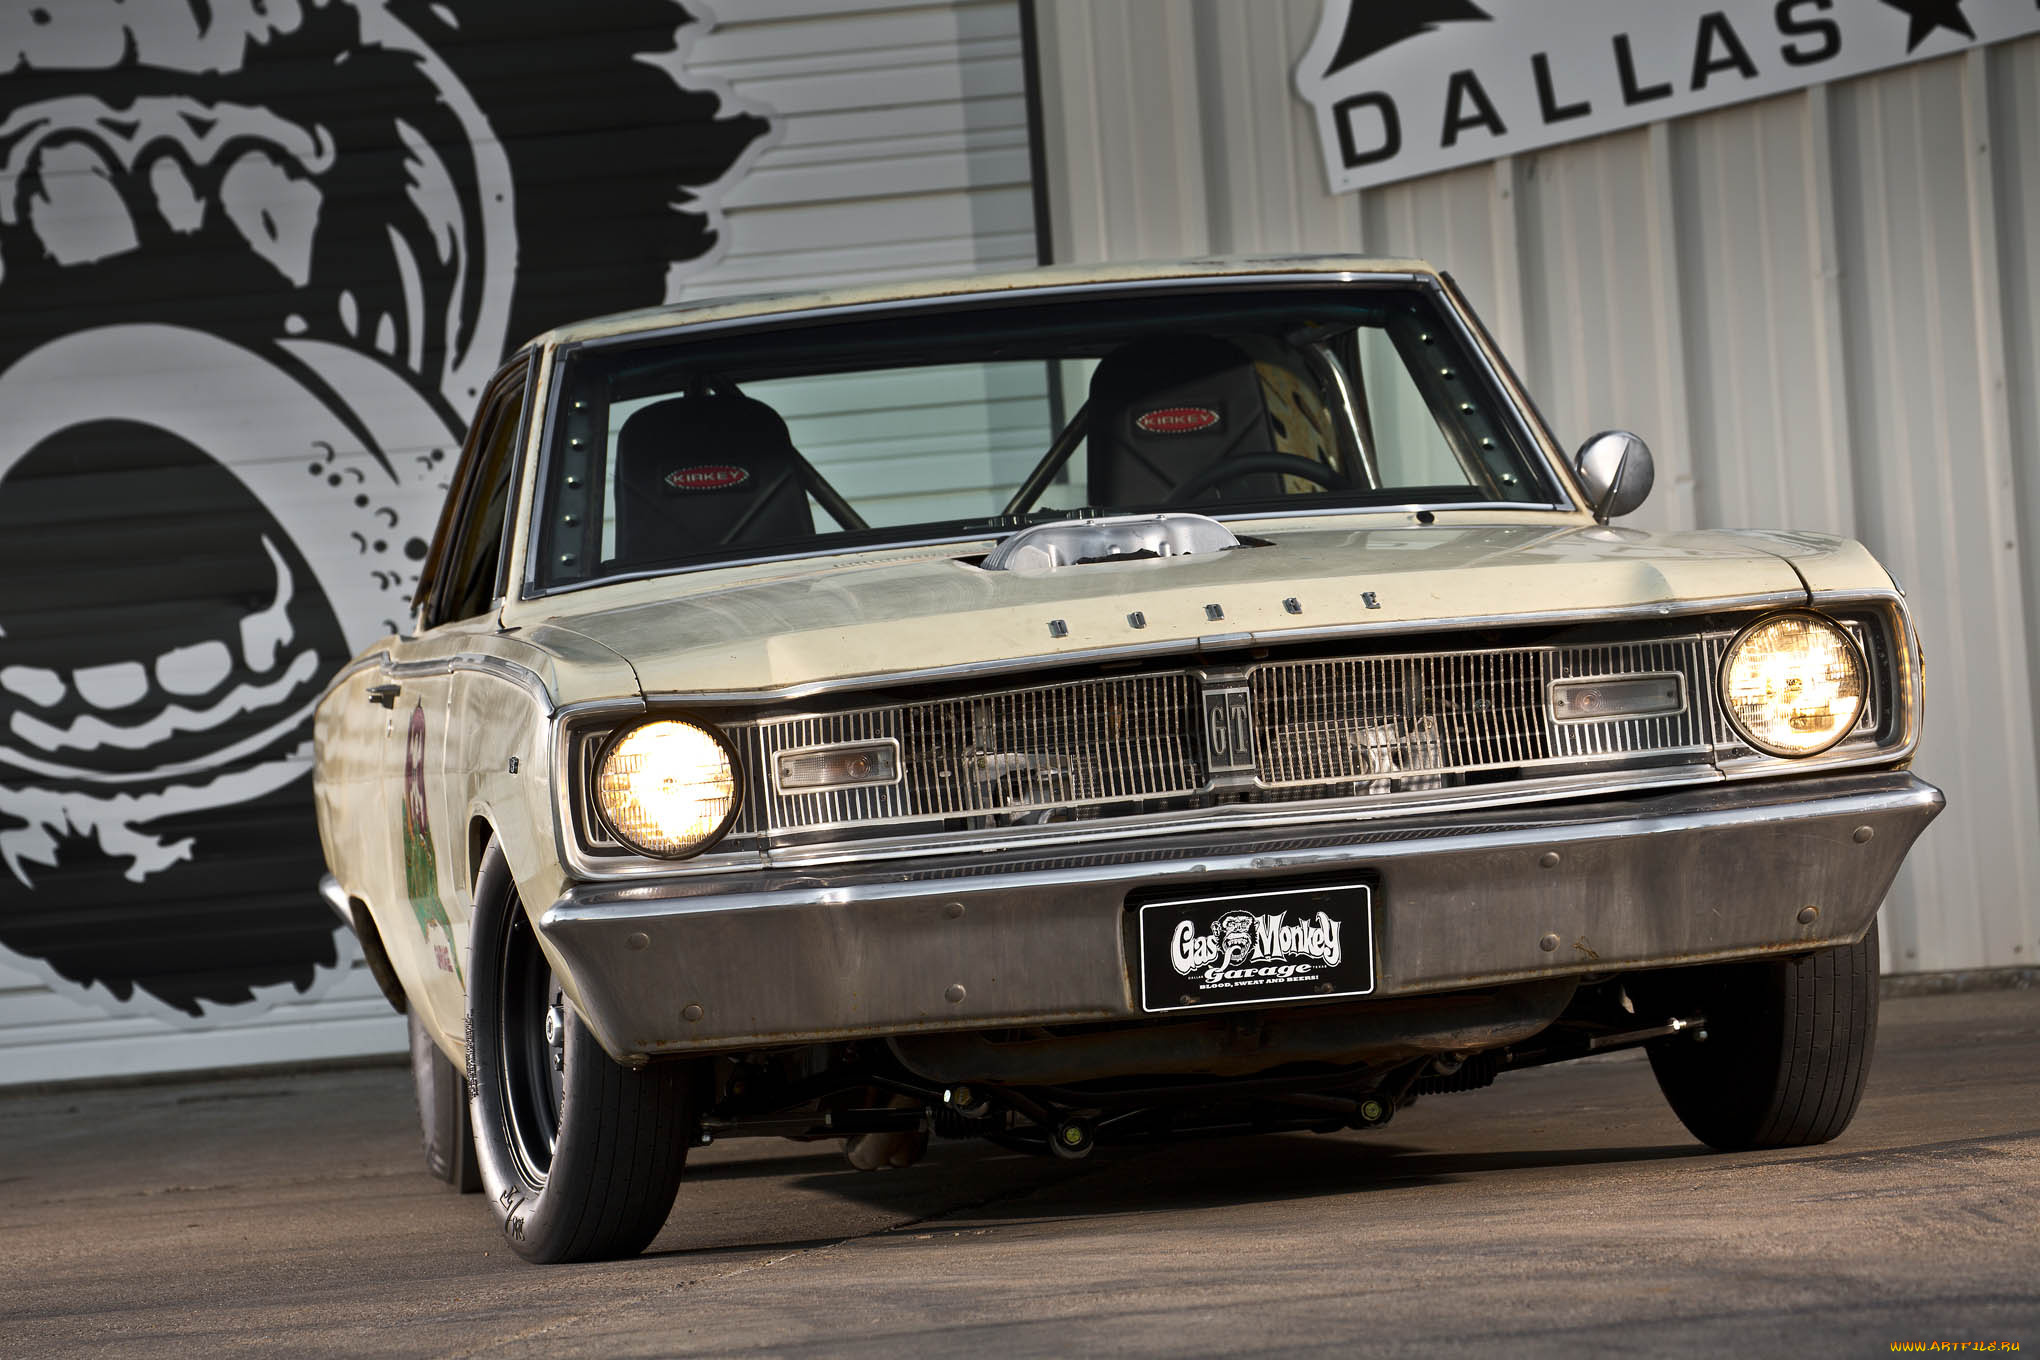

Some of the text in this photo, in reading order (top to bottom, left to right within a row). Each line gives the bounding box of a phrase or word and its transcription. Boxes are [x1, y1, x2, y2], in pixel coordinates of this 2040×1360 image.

[1332, 0, 1843, 169] DALLAS
[1144, 413, 1210, 425] KIRKEY
[673, 471, 739, 482] KIRKEY
[1209, 704, 1248, 755] GT
[1171, 910, 1342, 975] Gas Monkey
[1204, 963, 1312, 983] Garage
[1200, 981, 1234, 990] BLOOD,
